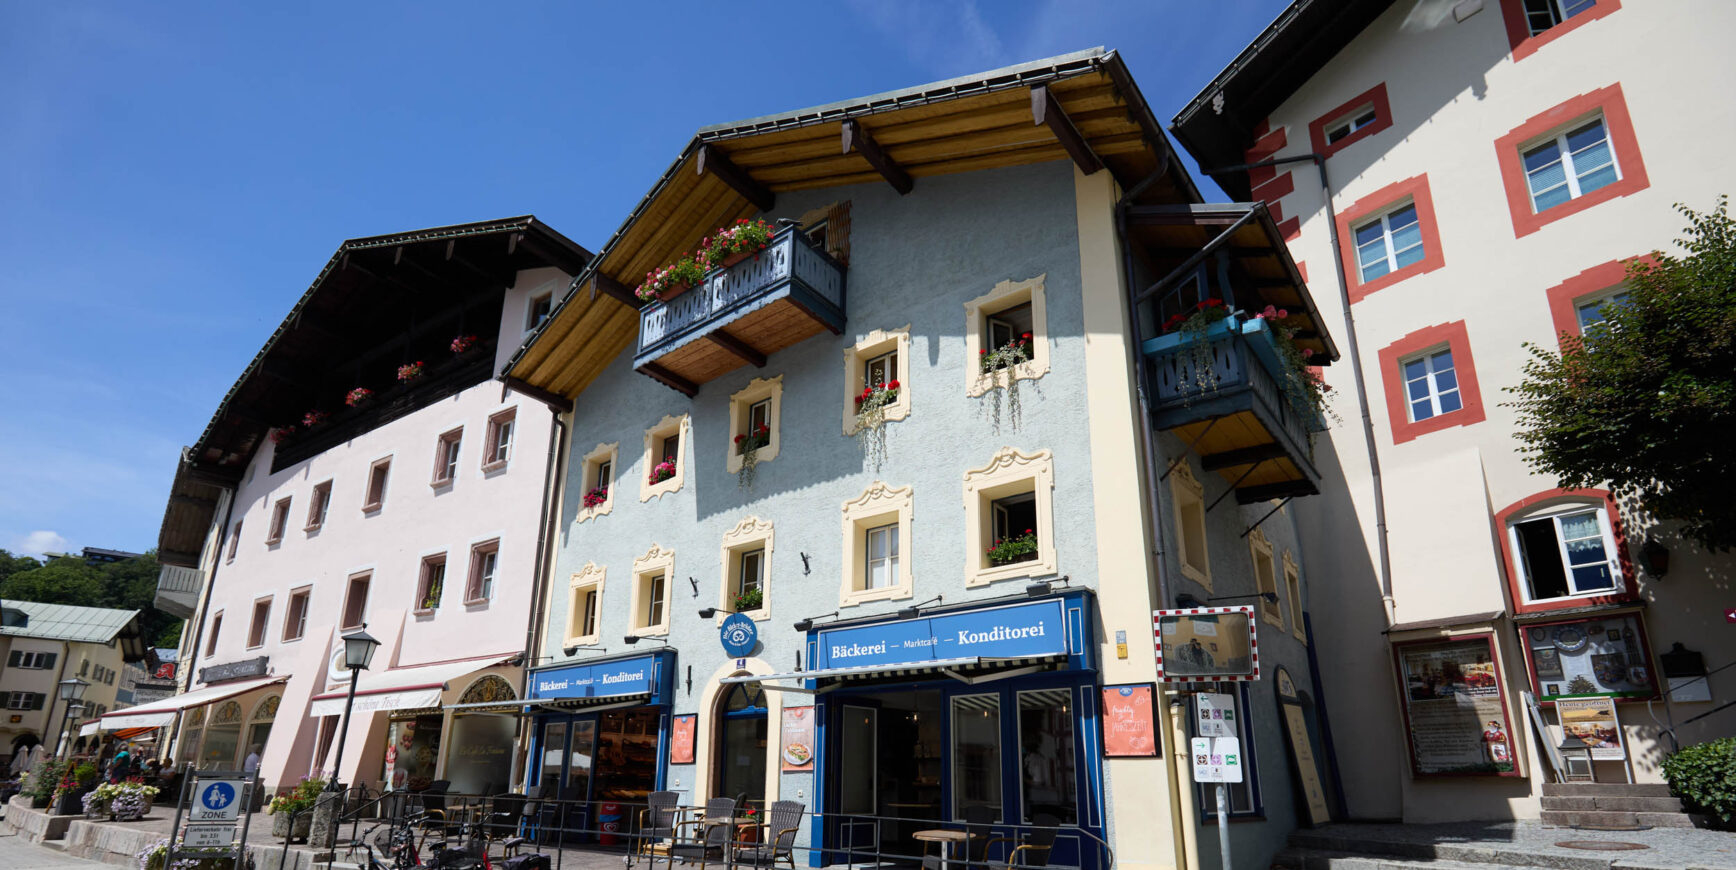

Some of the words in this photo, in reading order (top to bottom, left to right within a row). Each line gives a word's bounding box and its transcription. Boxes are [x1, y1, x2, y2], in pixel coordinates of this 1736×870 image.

[831, 640, 886, 659] Bäckerei
[903, 636, 938, 649] Marktcafé
[958, 621, 1045, 645] Konditorei
[540, 679, 569, 692] Bäckerei
[602, 669, 644, 685] Konditorei
[201, 811, 227, 819] ZONE
